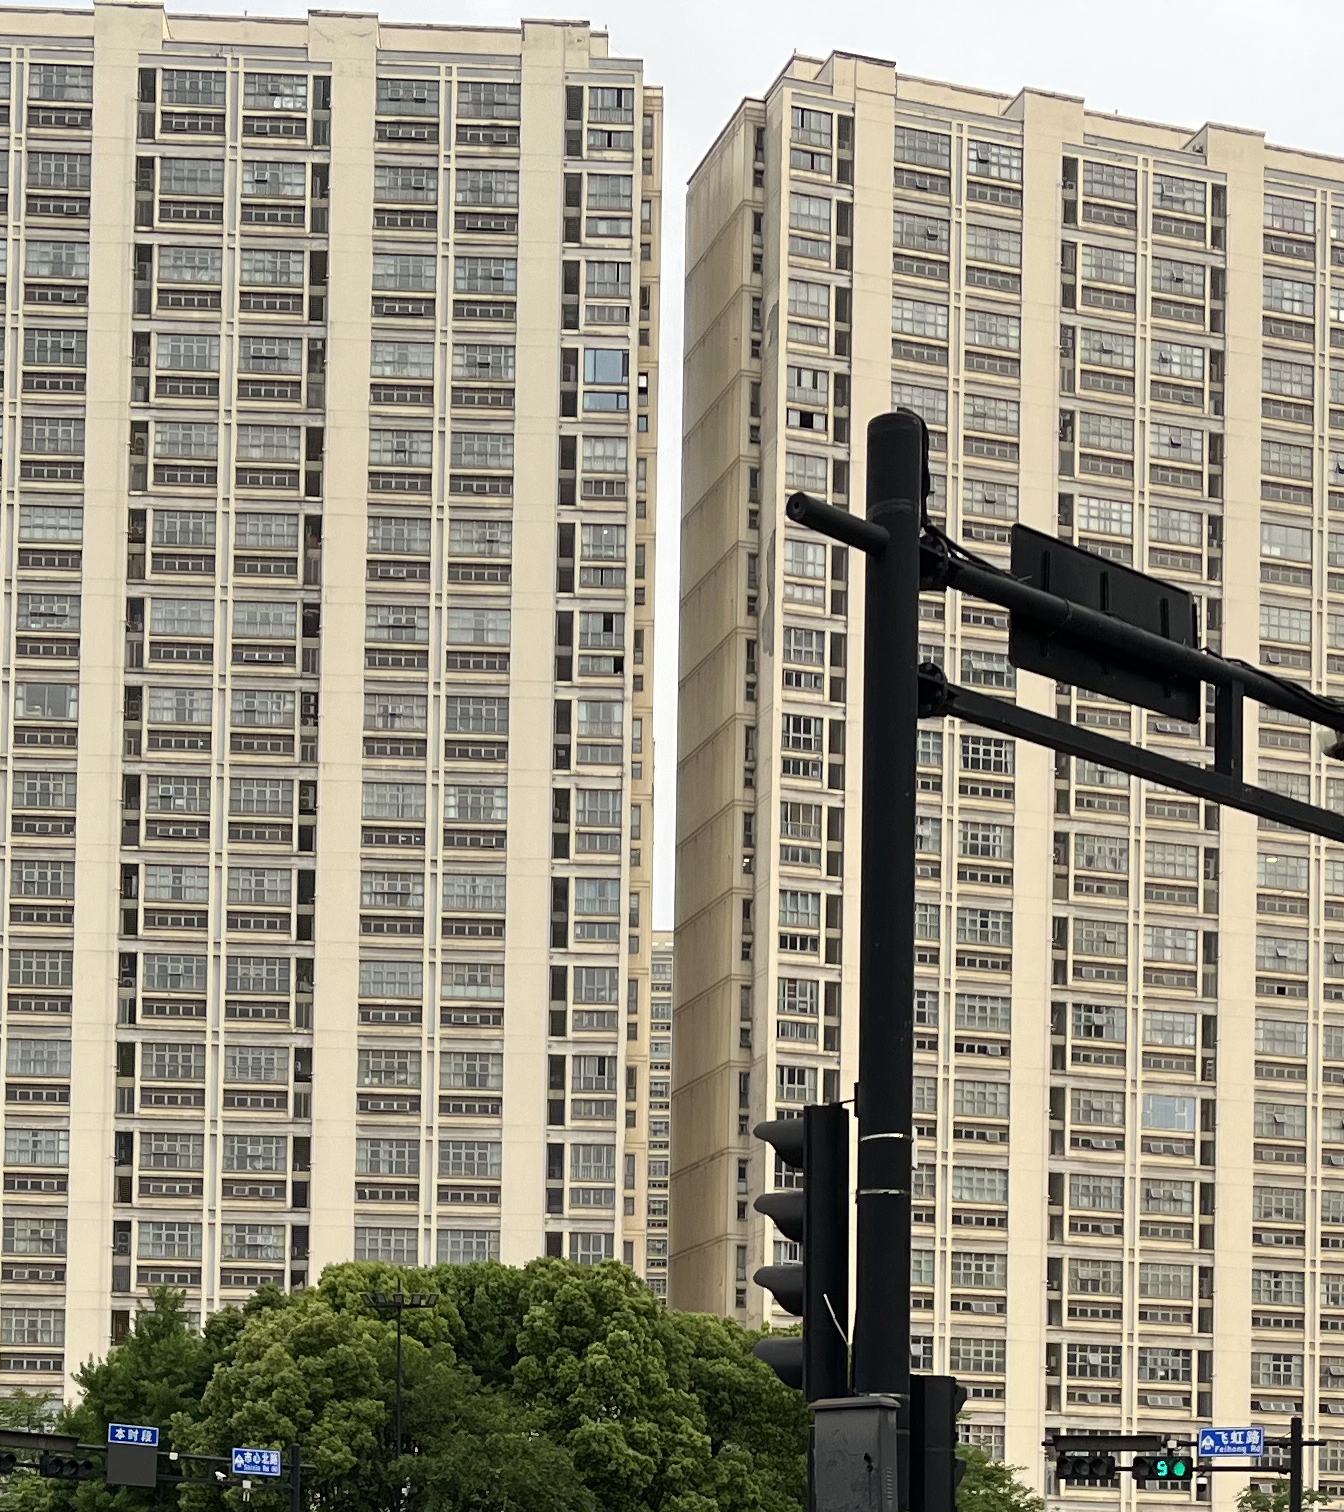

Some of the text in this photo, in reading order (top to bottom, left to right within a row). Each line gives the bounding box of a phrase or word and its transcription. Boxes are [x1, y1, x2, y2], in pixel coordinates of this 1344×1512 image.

[115, 1427, 153, 1443] 本时段
[1214, 1430, 1260, 1445] 飞虹路
[243, 1451, 278, 1466] 市心北路
[1156, 1460, 1168, 1477] 9
